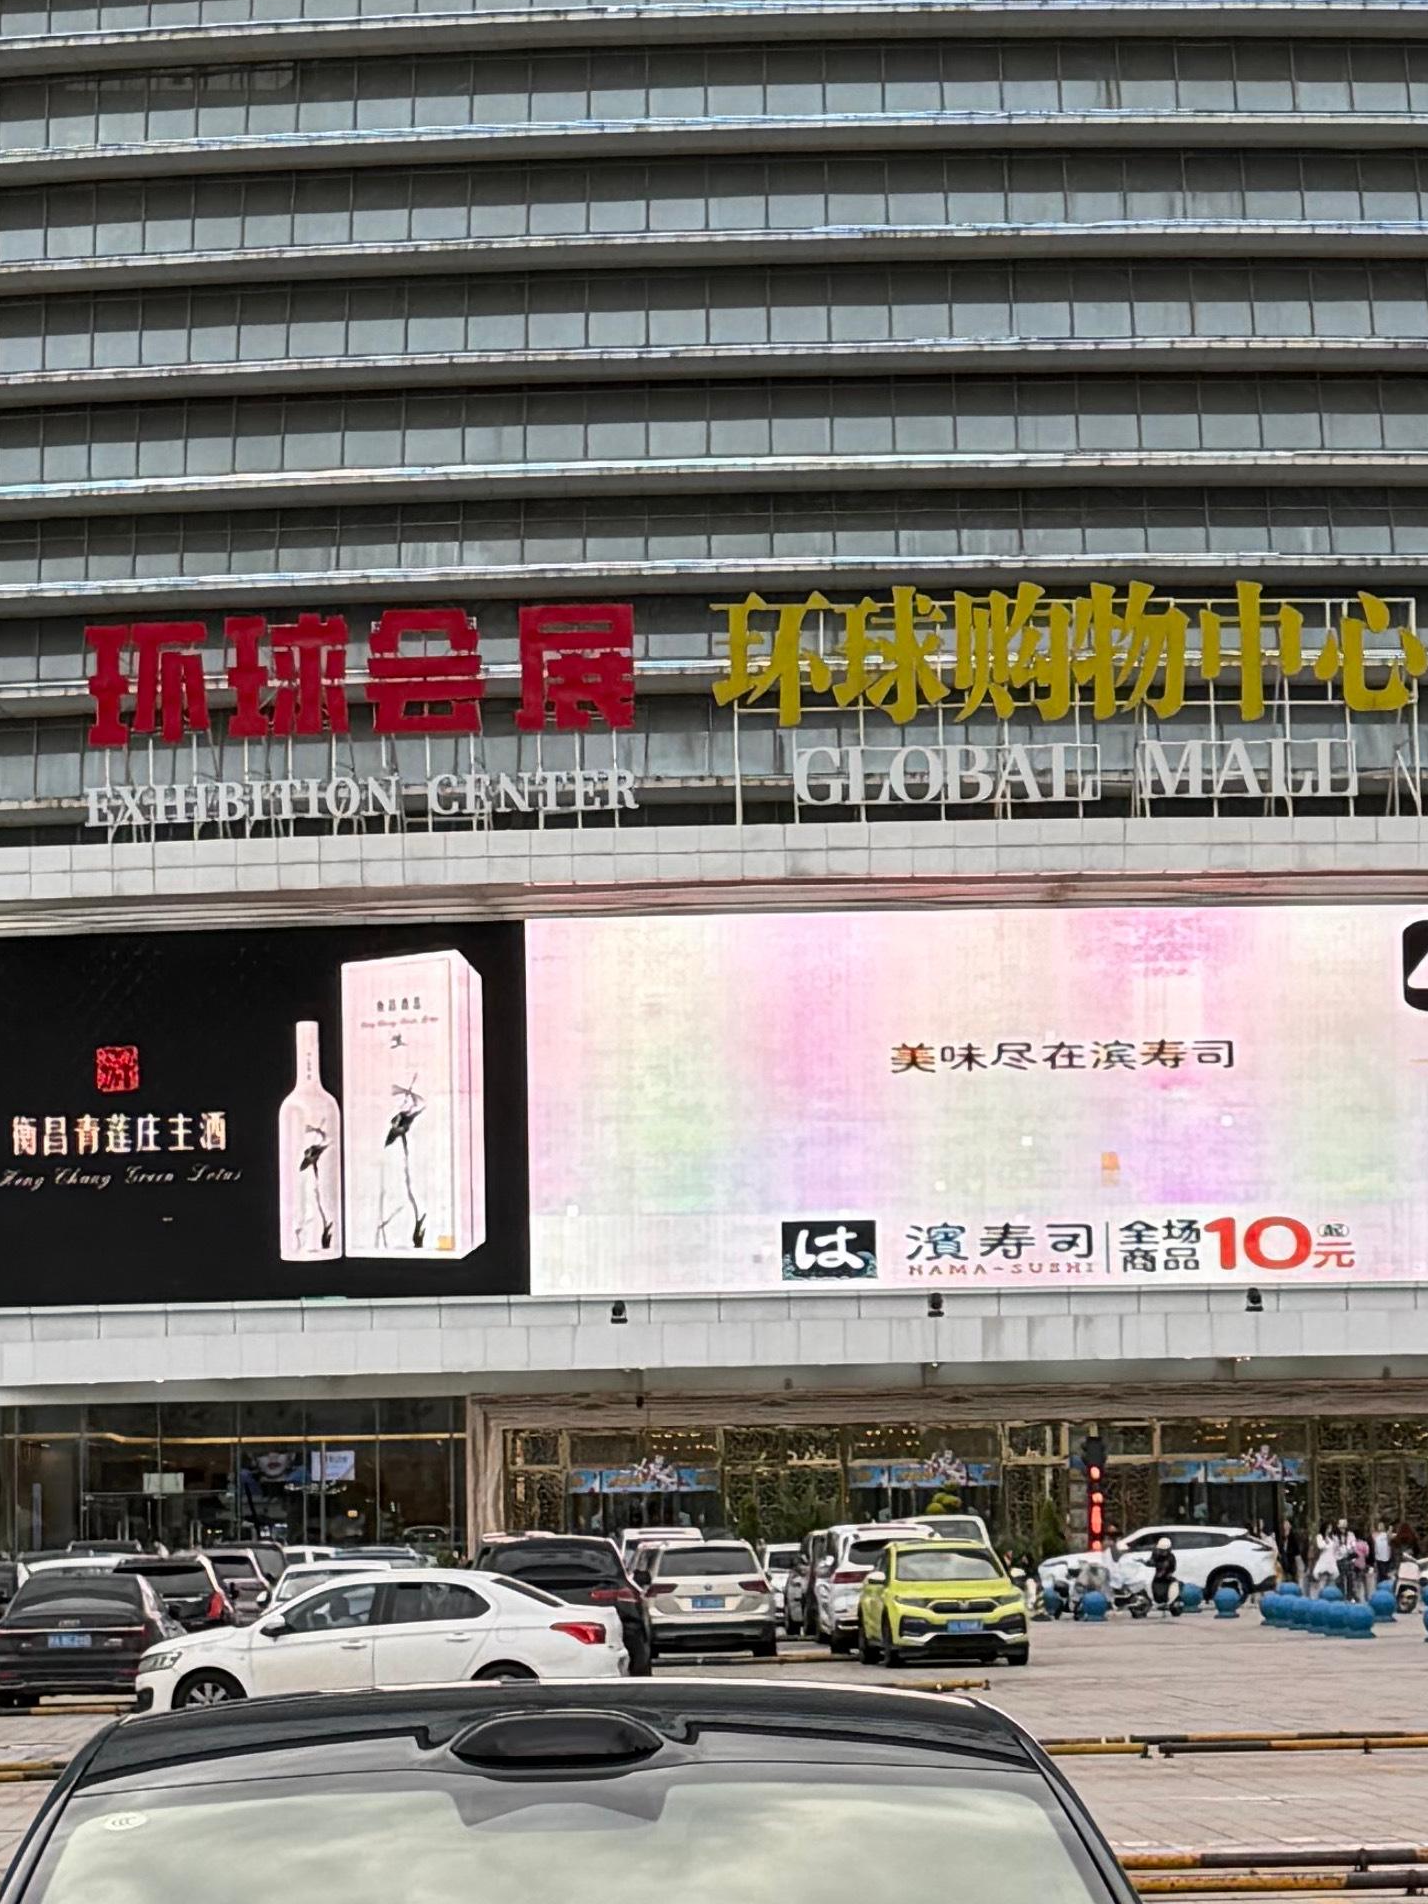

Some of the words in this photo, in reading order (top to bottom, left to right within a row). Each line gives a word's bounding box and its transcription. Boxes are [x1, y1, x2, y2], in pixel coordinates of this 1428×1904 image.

[85, 603, 635, 746] 环球会展
[713, 580, 1428, 726] 环球购物中心
[795, 744, 1098, 807] GLOBAL
[1143, 740, 1357, 798] MALL
[86, 777, 399, 827] EXHIBITION
[428, 769, 638, 815] CENTER
[891, 1039, 1235, 1073] 美味尽在滨寿司
[12, 1111, 227, 1156] 衡昌青莲庄主酒
[795, 1226, 865, 1270] は
[1118, 1219, 1200, 1245] 全场
[908, 1262, 1096, 1276] HAMA-SUSHI
[1121, 1247, 1200, 1272] 商品
